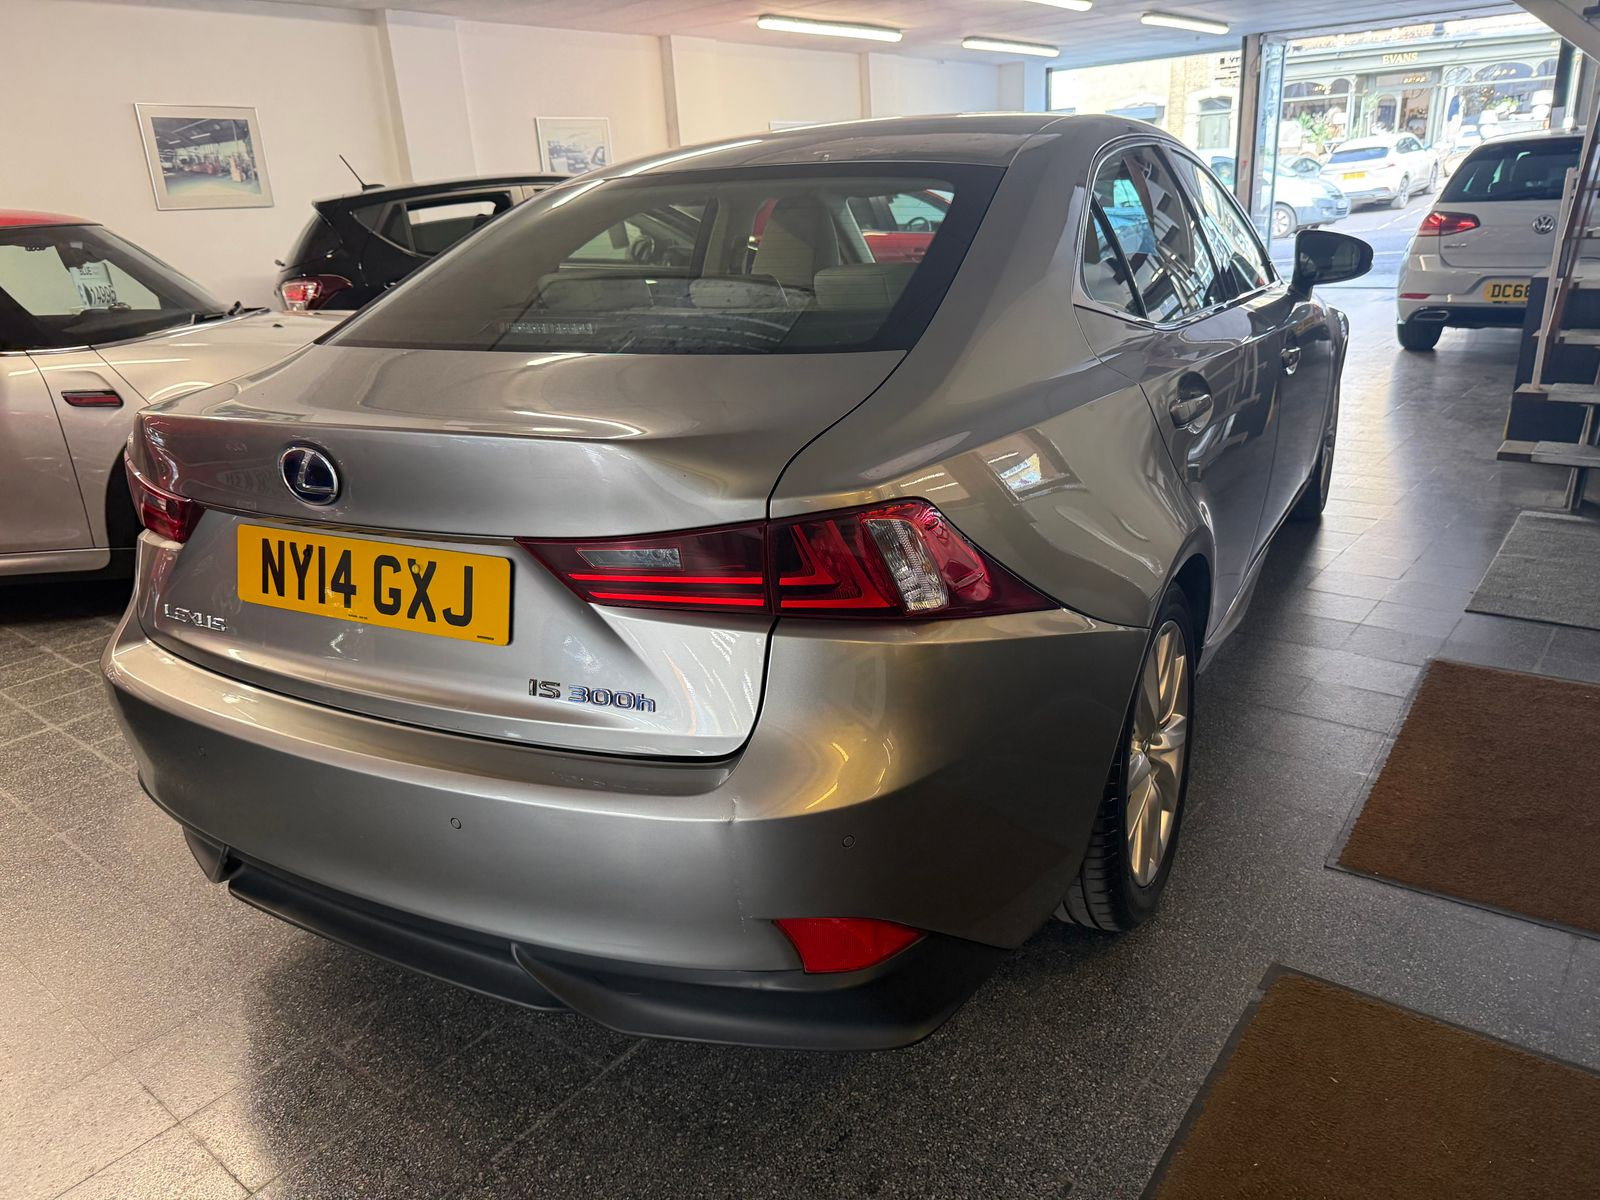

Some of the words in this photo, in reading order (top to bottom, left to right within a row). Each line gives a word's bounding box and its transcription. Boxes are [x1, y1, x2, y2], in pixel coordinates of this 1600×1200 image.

[261, 537, 357, 609] NY14
[373, 554, 474, 628] GXJ
[163, 603, 227, 632] LEXUS
[528, 679, 561, 699] IS
[568, 684, 656, 713] 300h
